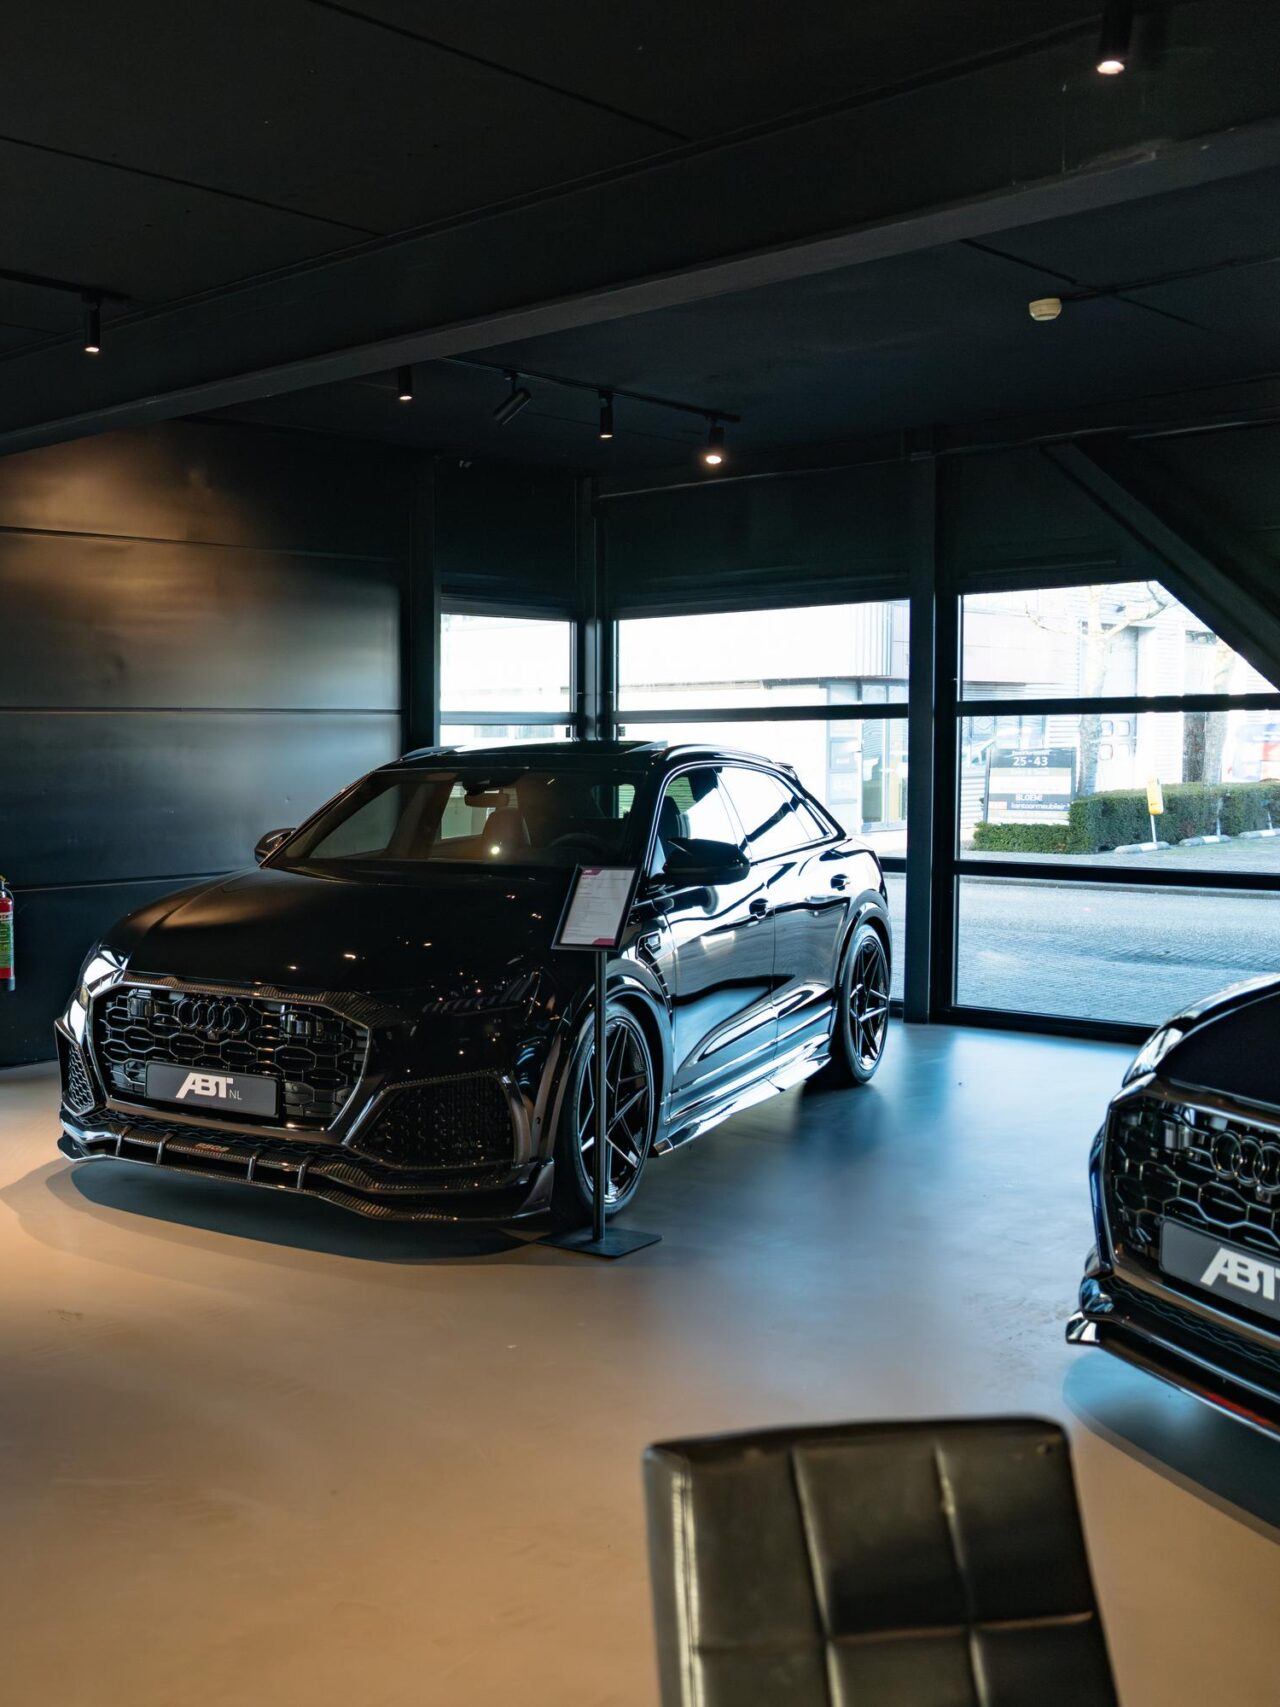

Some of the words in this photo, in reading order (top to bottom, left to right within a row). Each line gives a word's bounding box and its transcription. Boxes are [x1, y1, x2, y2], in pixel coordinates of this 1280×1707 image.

[176, 1072, 233, 1099] ABT
[228, 1089, 243, 1100] NL
[1200, 1246, 1280, 1301] ABT
